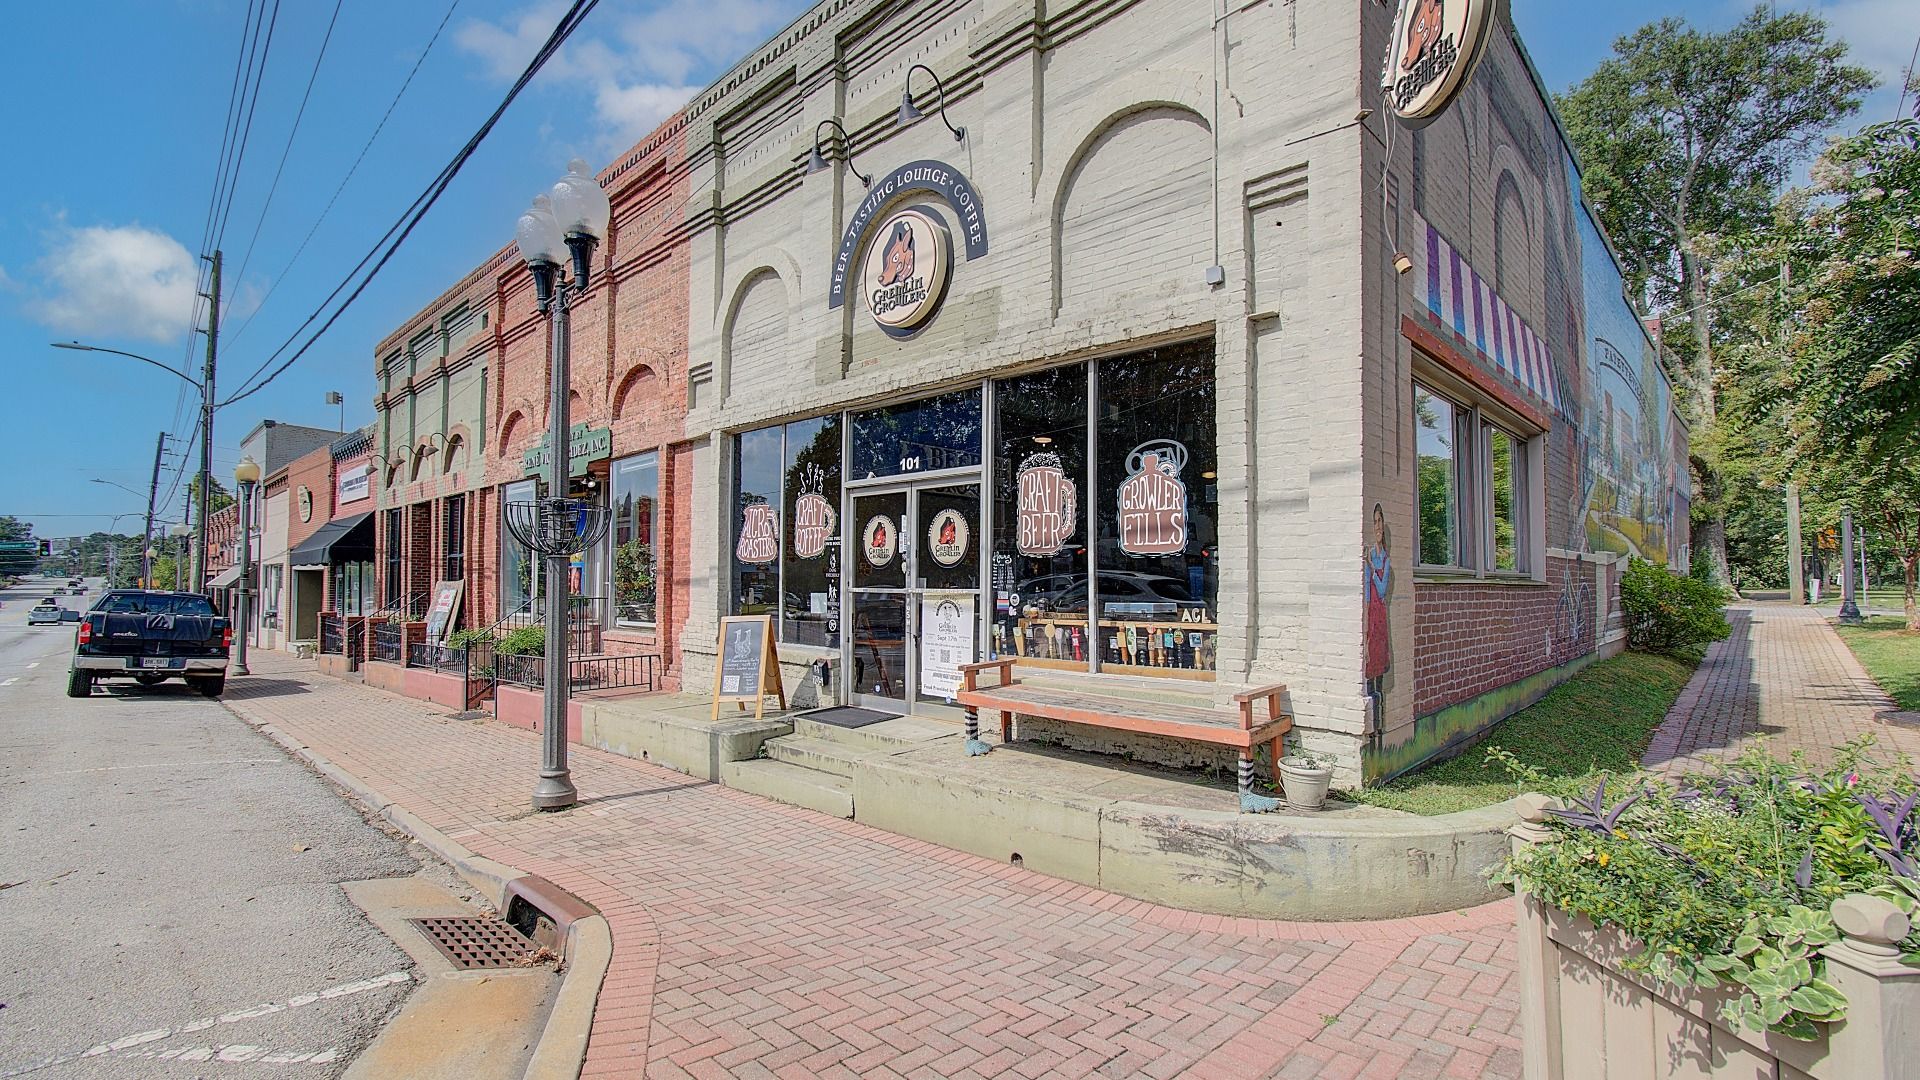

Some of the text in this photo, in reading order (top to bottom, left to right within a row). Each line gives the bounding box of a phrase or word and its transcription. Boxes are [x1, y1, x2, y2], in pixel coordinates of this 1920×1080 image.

[833, 166, 982, 295] BEER TASTING LOUNGE COFFEE
[899, 456, 920, 471] 101
[1130, 446, 1181, 473] OEN
[1021, 470, 1063, 513] CRAFT
[1122, 474, 1182, 511] GROWLER
[741, 508, 770, 539] MICRO
[797, 497, 826, 526] CRAFT
[796, 526, 824, 555] COFFEE
[1020, 513, 1061, 549] BEER
[1123, 513, 1183, 546] FILLS
[739, 538, 775, 559] ROASTERY
[1181, 607, 1212, 624] ACL
